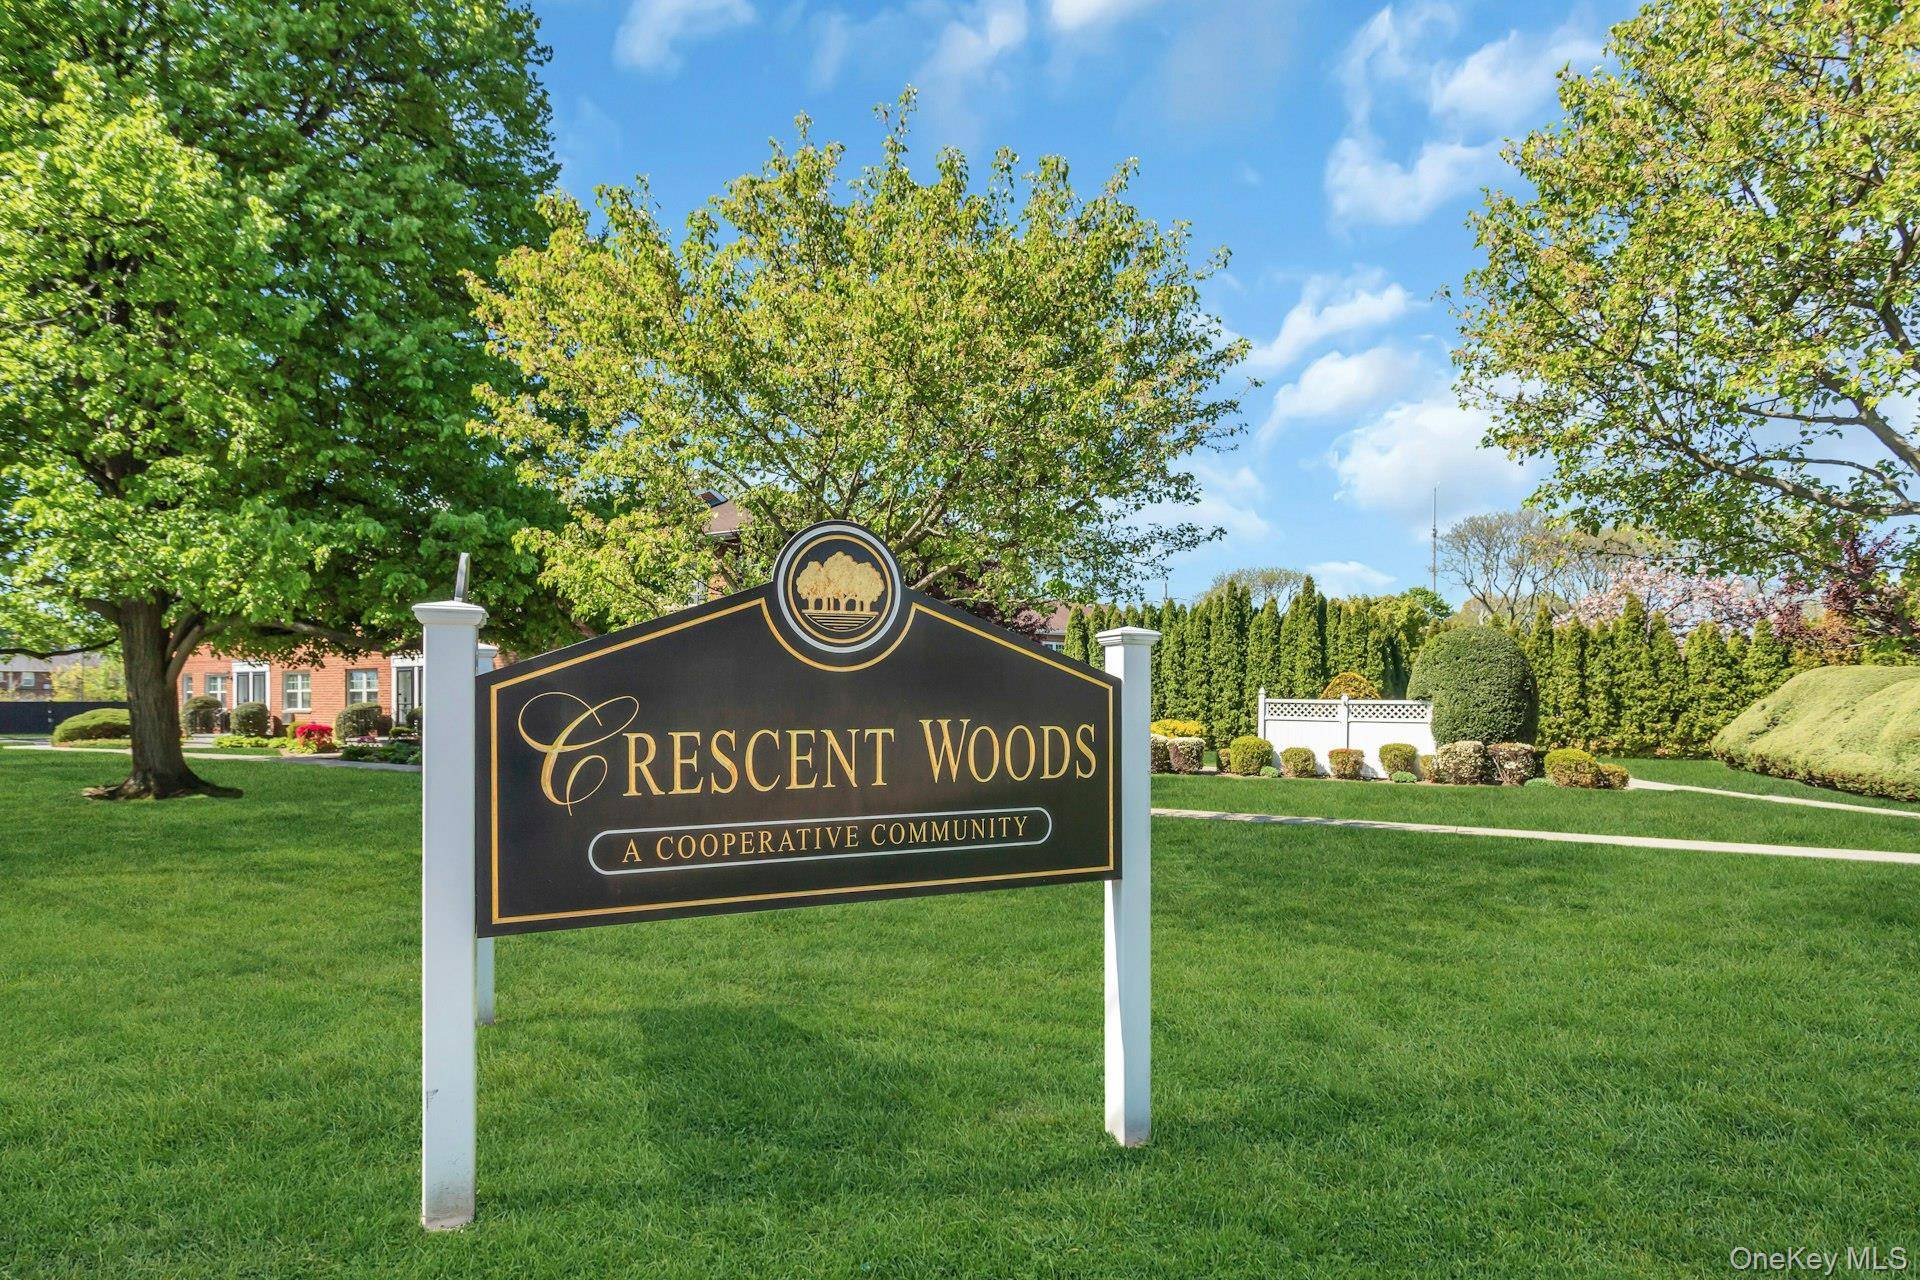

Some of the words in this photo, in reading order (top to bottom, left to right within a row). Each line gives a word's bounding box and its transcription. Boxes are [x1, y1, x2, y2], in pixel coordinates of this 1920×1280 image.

[517, 691, 895, 817] CRESCENT
[918, 718, 1098, 785] WOODS
[621, 840, 643, 864] A
[655, 825, 860, 861] COOPERATIVE
[871, 815, 1029, 847] COMMUNITY
